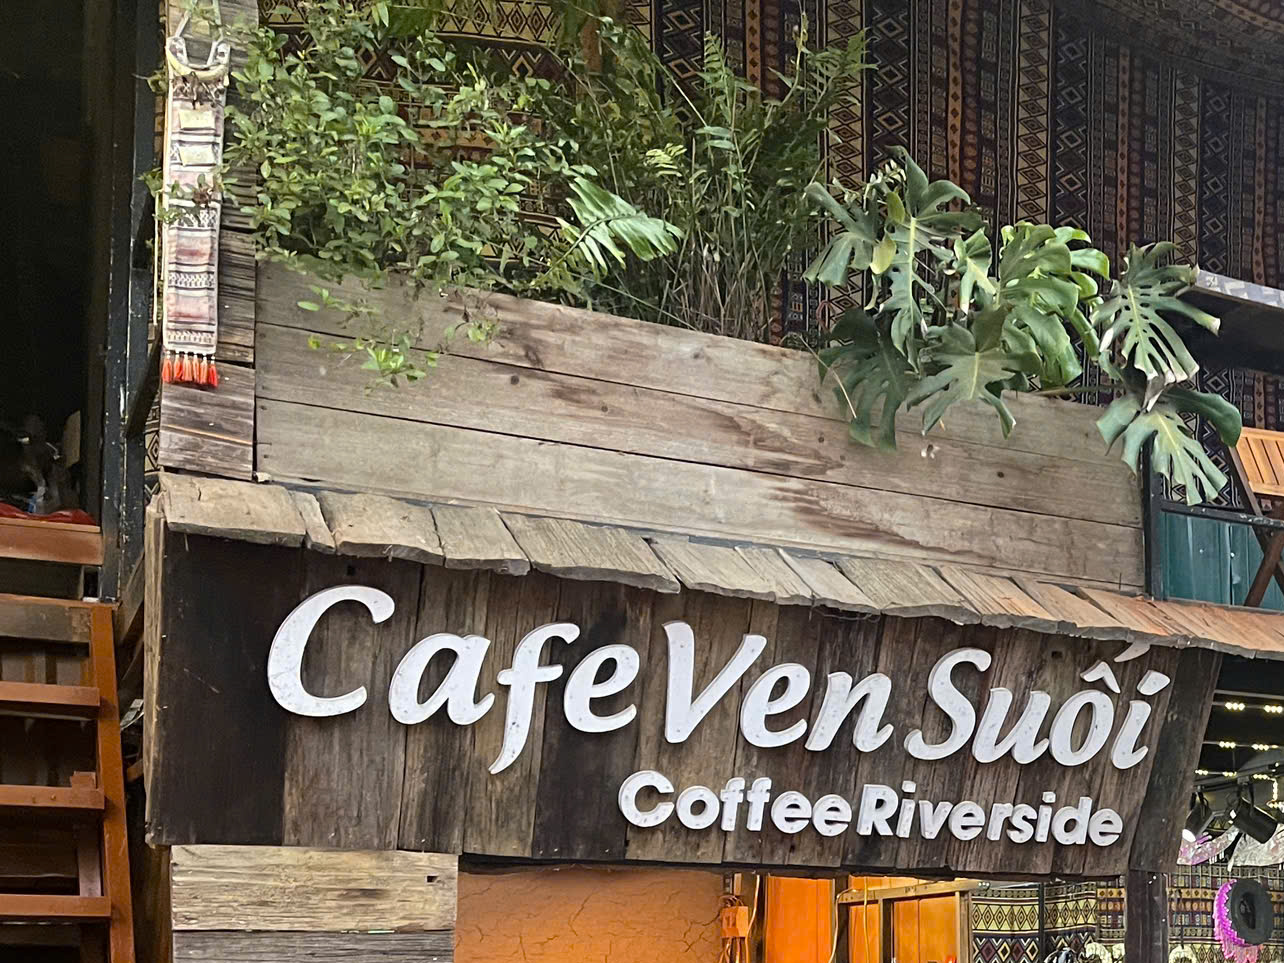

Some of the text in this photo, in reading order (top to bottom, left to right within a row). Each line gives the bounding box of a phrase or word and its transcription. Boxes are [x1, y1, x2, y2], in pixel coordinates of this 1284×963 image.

[267, 585, 1171, 775] Cafe Ven Suối
[618, 769, 1124, 848] Coffee Riverside
